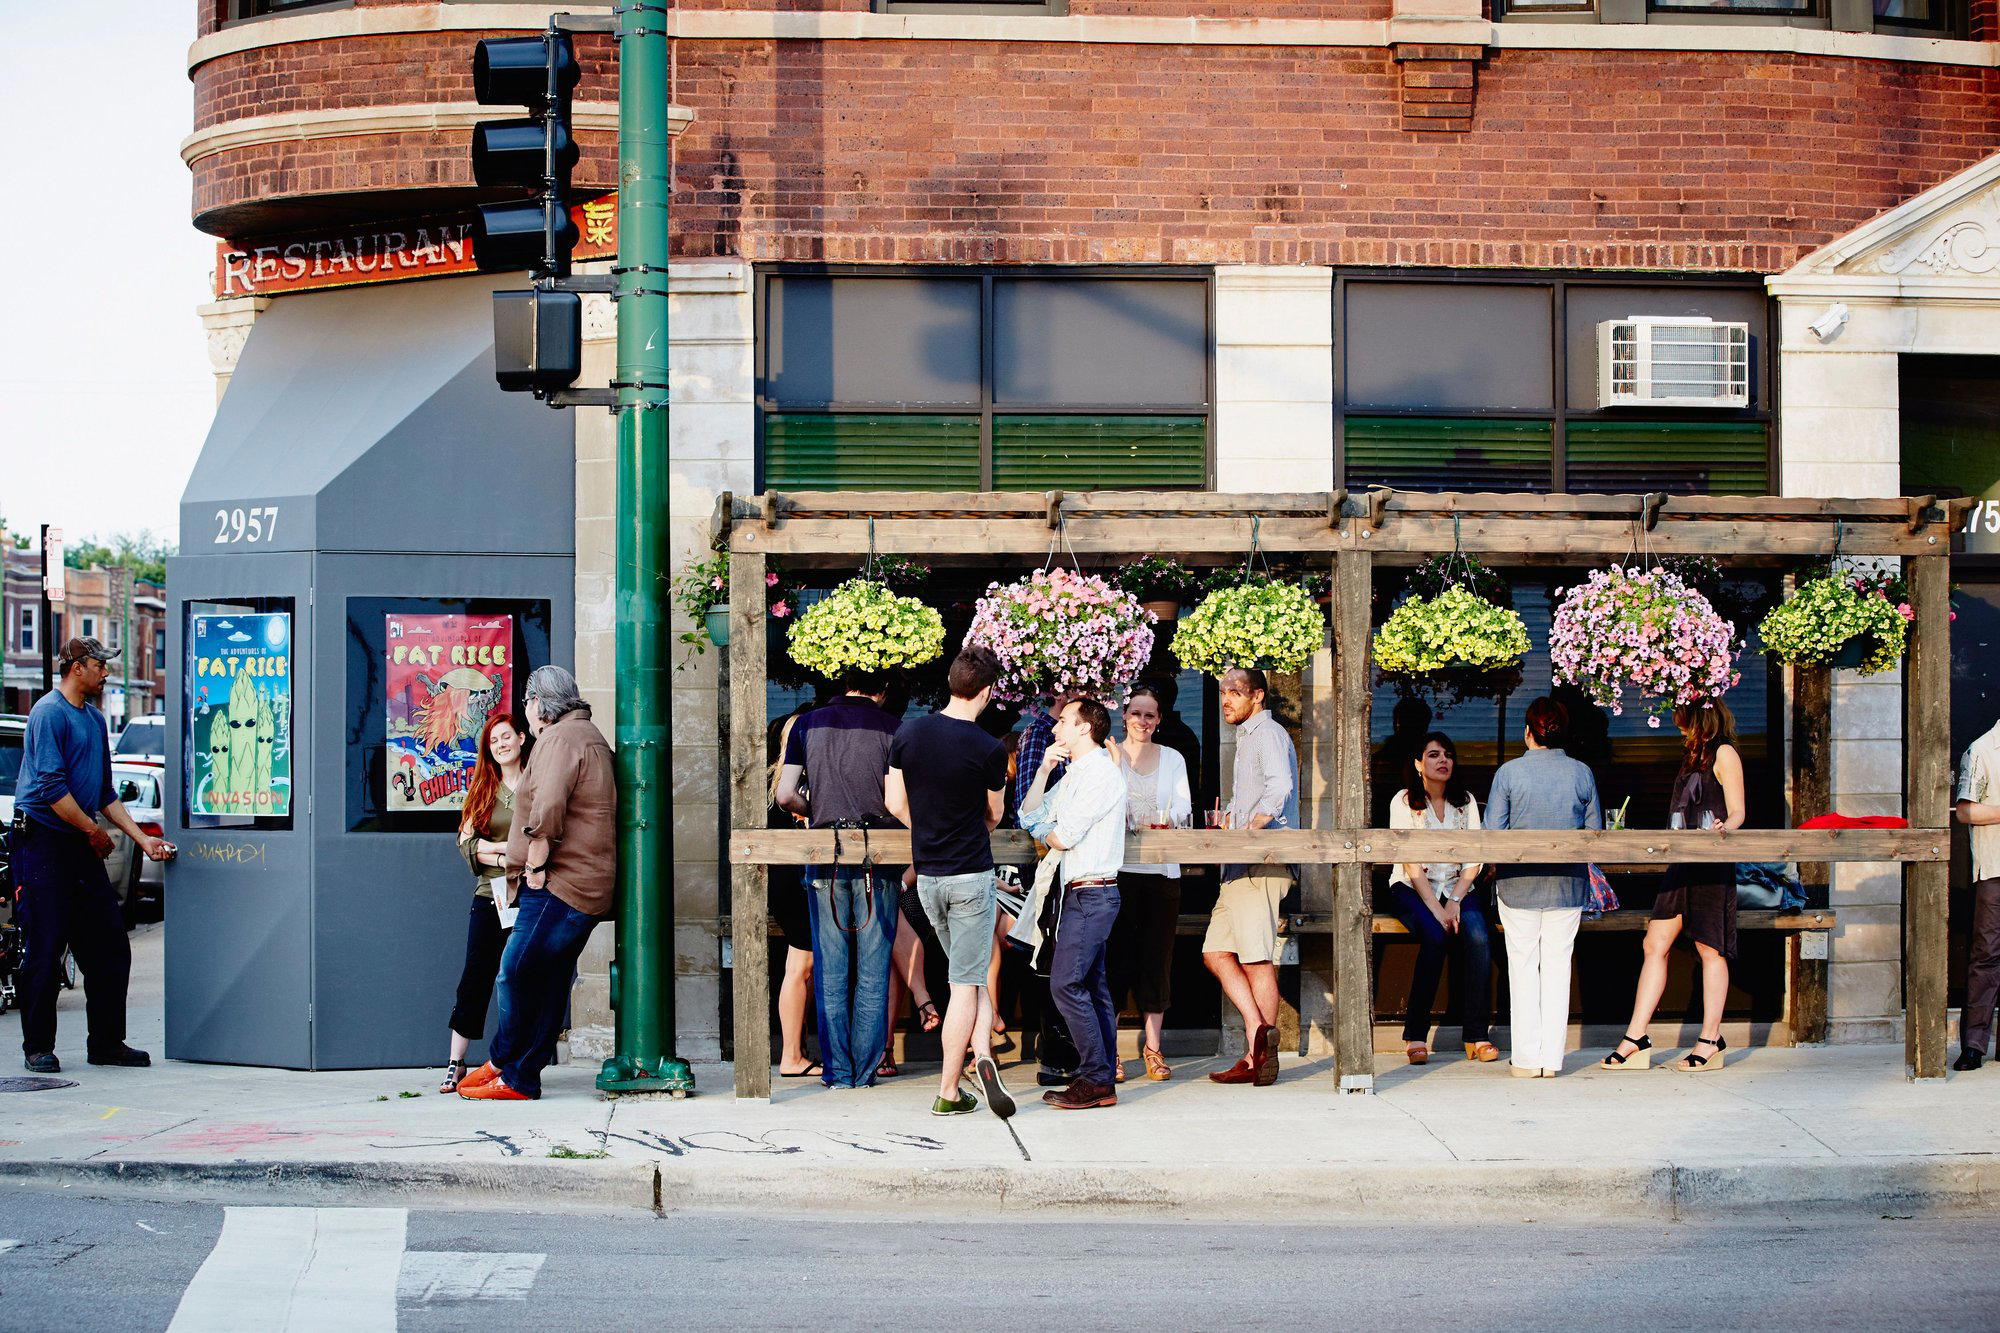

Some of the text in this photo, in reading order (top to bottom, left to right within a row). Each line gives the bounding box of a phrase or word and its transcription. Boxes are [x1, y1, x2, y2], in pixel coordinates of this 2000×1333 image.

[223, 223, 474, 295] RESTAURAN
[214, 506, 279, 544] 2957
[1961, 500, 2000, 533] 75
[198, 656, 286, 678] FAT RICE
[393, 645, 506, 665] FAT RICE
[203, 791, 284, 805] INVASION
[419, 769, 463, 806] CHILLI
